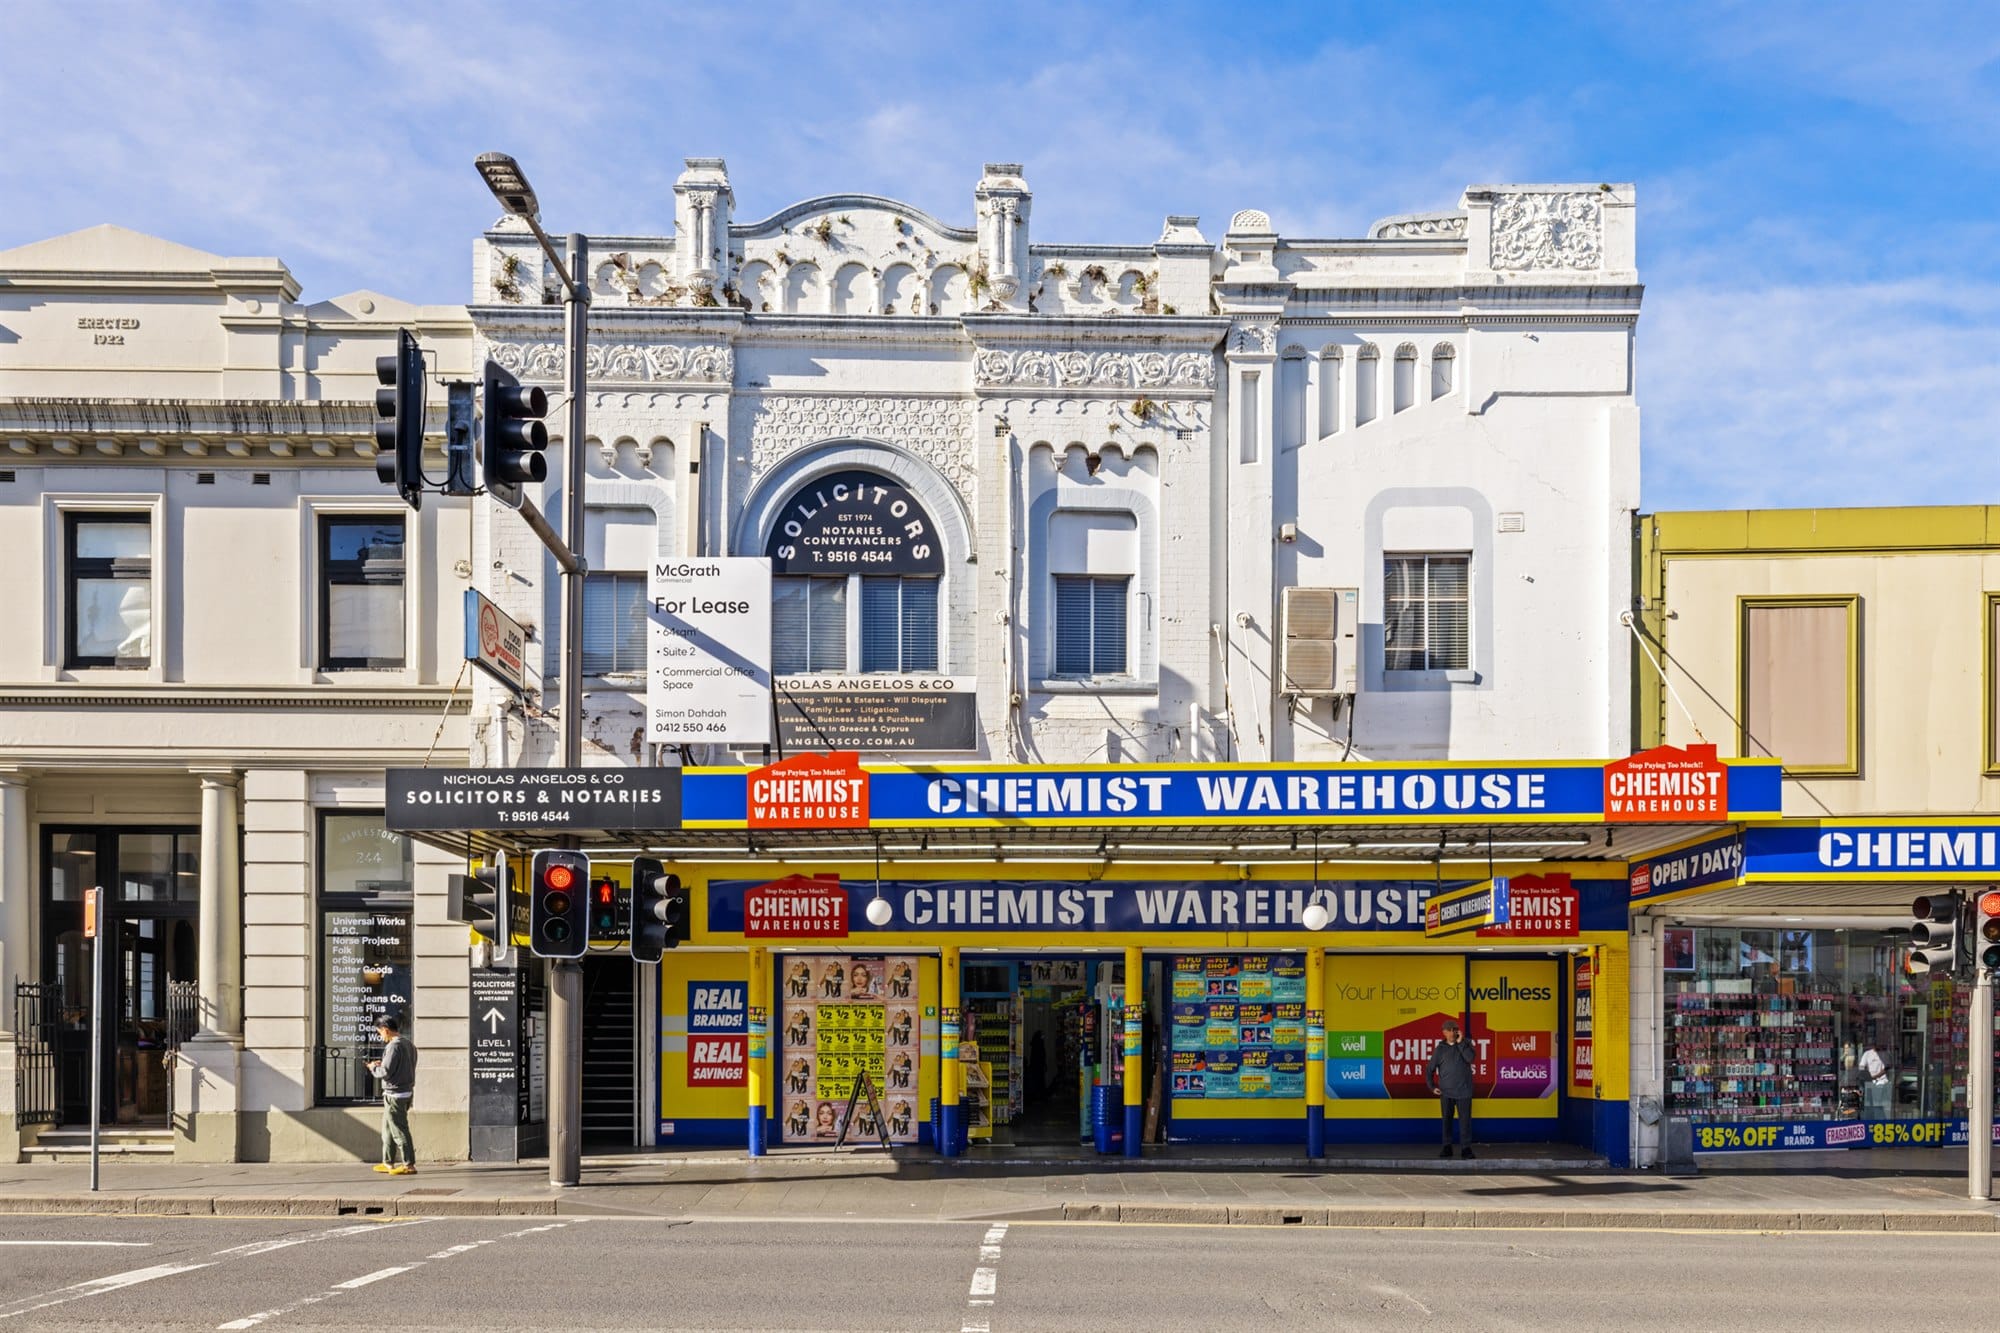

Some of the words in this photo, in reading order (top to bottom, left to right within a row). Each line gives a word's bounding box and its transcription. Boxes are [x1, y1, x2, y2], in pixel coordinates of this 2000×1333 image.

[78, 318, 140, 329] ERECTED
[94, 334, 125, 345] 1922
[777, 483, 931, 560] SOLICITORS
[823, 527, 883, 535] NOTARIES
[803, 537, 902, 545] CONVEYANCERS
[812, 551, 823, 562] T:
[827, 551, 857, 562] 9516
[861, 551, 893, 562] 4544
[656, 564, 720, 577] McGrath
[655, 596, 686, 614] For
[692, 596, 750, 614] Lease
[663, 647, 687, 656] Suite
[689, 647, 696, 656] 2
[662, 667, 722, 677] Commercial
[724, 667, 755, 677] Office
[663, 680, 694, 691] Space
[777, 680, 832, 690] HOLAS
[837, 680, 914, 690] ANGELOS
[919, 680, 929, 690] &
[932, 680, 954, 690] CO
[911, 696, 947, 704] Disputes
[656, 709, 685, 718] Simon
[688, 709, 727, 718] Dahdah
[805, 706, 832, 714] Family
[860, 706, 899, 714] Litigation
[656, 723, 680, 732] 0412
[683, 723, 704, 732] 550
[706, 723, 727, 732] 466
[785, 737, 915, 746] ANGELOSCO.COM.AU
[1628, 762, 1643, 770] Stop
[1644, 762, 1666, 770] Paying
[771, 769, 785, 777] Stop
[787, 769, 809, 777] Paying
[443, 775, 515, 785] NICHOLAS
[520, 775, 586, 784] ANGELOS
[590, 775, 600, 784] &
[603, 774, 624, 784] CO
[1609, 772, 1721, 797] CHEMIST
[406, 791, 526, 804] SOLICITORS
[537, 791, 550, 803] &
[561, 790, 662, 803] NOTARIES
[753, 779, 863, 804] CHEMIST
[926, 777, 1171, 814] CHEMIST
[1197, 773, 1547, 812] WAREHOUSE
[1610, 799, 1718, 812] WAREHOUSE
[498, 811, 508, 821] T:
[511, 811, 538, 822] 9516
[541, 811, 570, 821] 4544
[754, 806, 860, 819] WAREHOUSE
[1818, 832, 1996, 867] CHEMI
[1652, 858, 1687, 887] OPEN
[1690, 855, 1699, 877] 7
[1702, 843, 1742, 875] DAYS
[749, 897, 843, 917] CHEMIST
[904, 889, 1113, 924] CHEMIST
[1135, 888, 1430, 924] WAREHOUSE
[1440, 903, 1459, 920] CHEMIST
[1460, 894, 1491, 916] WAREHOUSE
[332, 917, 374, 926] Universal
[377, 916, 406, 926] Works
[750, 920, 840, 930] WAREHOUSE
[332, 926, 359, 935] A.P.C.
[332, 936, 360, 945] Norse
[361, 936, 400, 946] Projects
[332, 946, 352, 954] Folk
[332, 956, 364, 964] orSlow
[332, 966, 360, 974] Butter
[363, 966, 393, 974] Goods
[332, 975, 356, 983] Keen
[332, 985, 372, 993] Salomon
[1336, 983, 1376, 1000] Your
[1381, 983, 1440, 1000] House
[1444, 982, 1462, 1000] of
[1469, 977, 1552, 1001] wellness
[332, 995, 359, 1003] Nudie
[360, 995, 388, 1003] Jeans
[390, 995, 406, 1003] Co.
[693, 989, 743, 1010] REAL
[332, 1004, 364, 1012] Beams
[366, 1004, 386, 1012] Plus
[332, 1014, 373, 1022] Gramicci
[693, 1014, 743, 1026] BRANDS!
[332, 1024, 356, 1032] Brain
[332, 1033, 366, 1041] Service
[1341, 1036, 1366, 1051] well
[1512, 1035, 1536, 1051] well
[693, 1042, 743, 1063] REAL
[693, 1067, 743, 1080] SAVINGS!
[1341, 1064, 1366, 1079] well
[1500, 1066, 1548, 1079] fabulous
[1793, 1125, 1806, 1135] BIG
[1873, 1124, 1909, 1143] 85%
[1911, 1123, 1941, 1142] OFF
[1701, 1127, 1740, 1147] 85%
[1743, 1126, 1777, 1146] OFF
[1784, 1136, 1815, 1146] BRANDS
